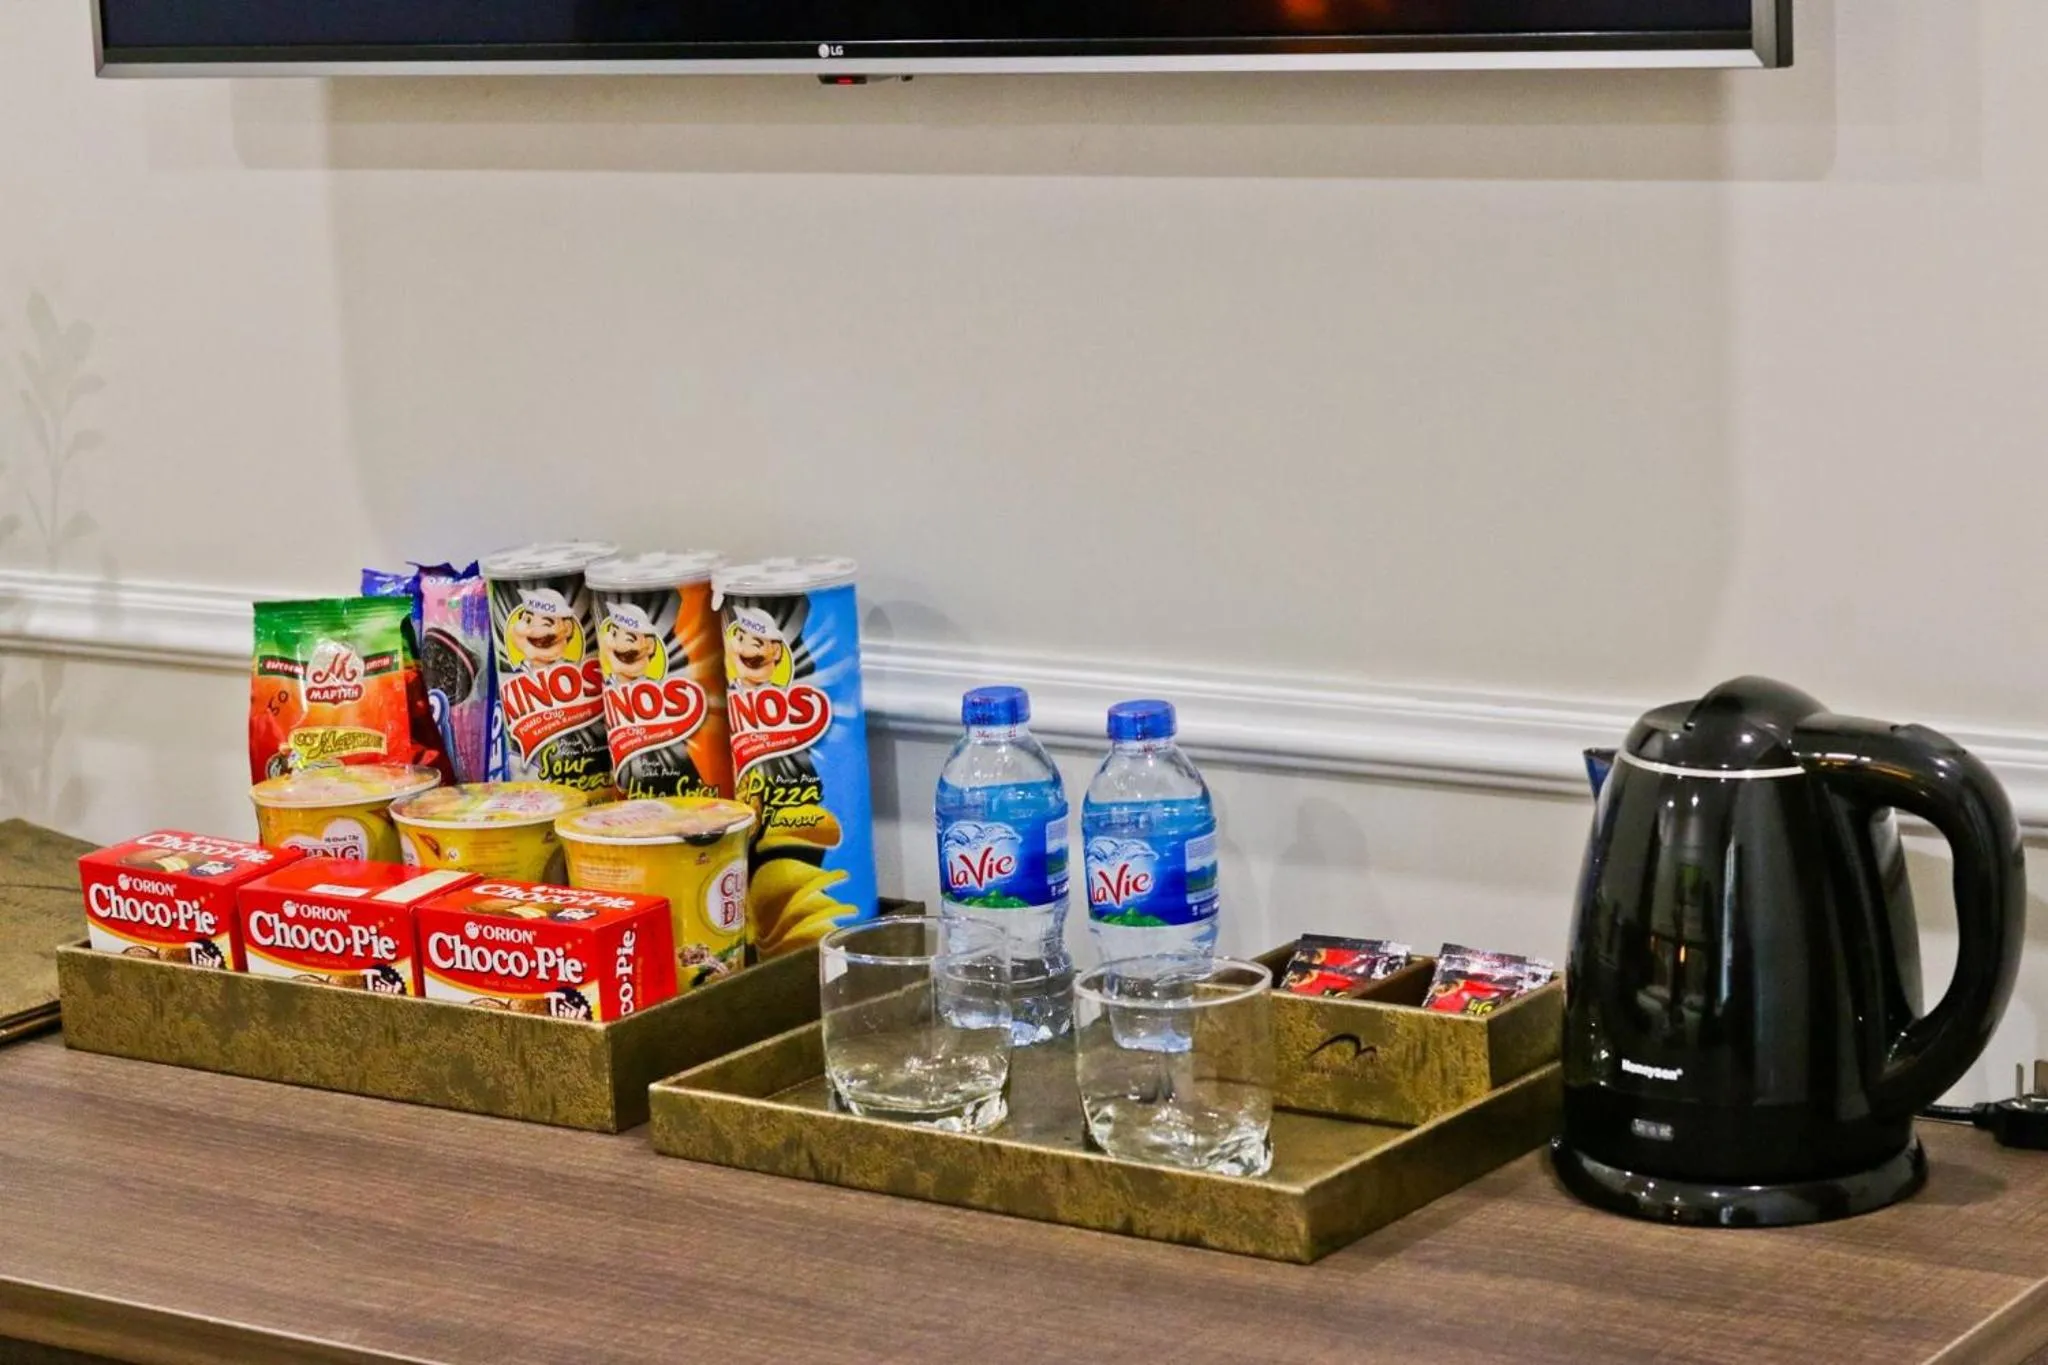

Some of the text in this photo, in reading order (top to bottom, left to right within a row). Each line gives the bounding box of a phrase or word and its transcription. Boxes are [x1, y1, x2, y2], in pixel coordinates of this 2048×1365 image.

[529, 599, 557, 613] KINOS
[538, 742, 597, 780] Sour
[746, 769, 821, 806] Pizza
[761, 806, 825, 827] Flavour
[132, 877, 175, 897] ORION
[300, 904, 348, 923] ORION
[482, 925, 534, 945] ORION
